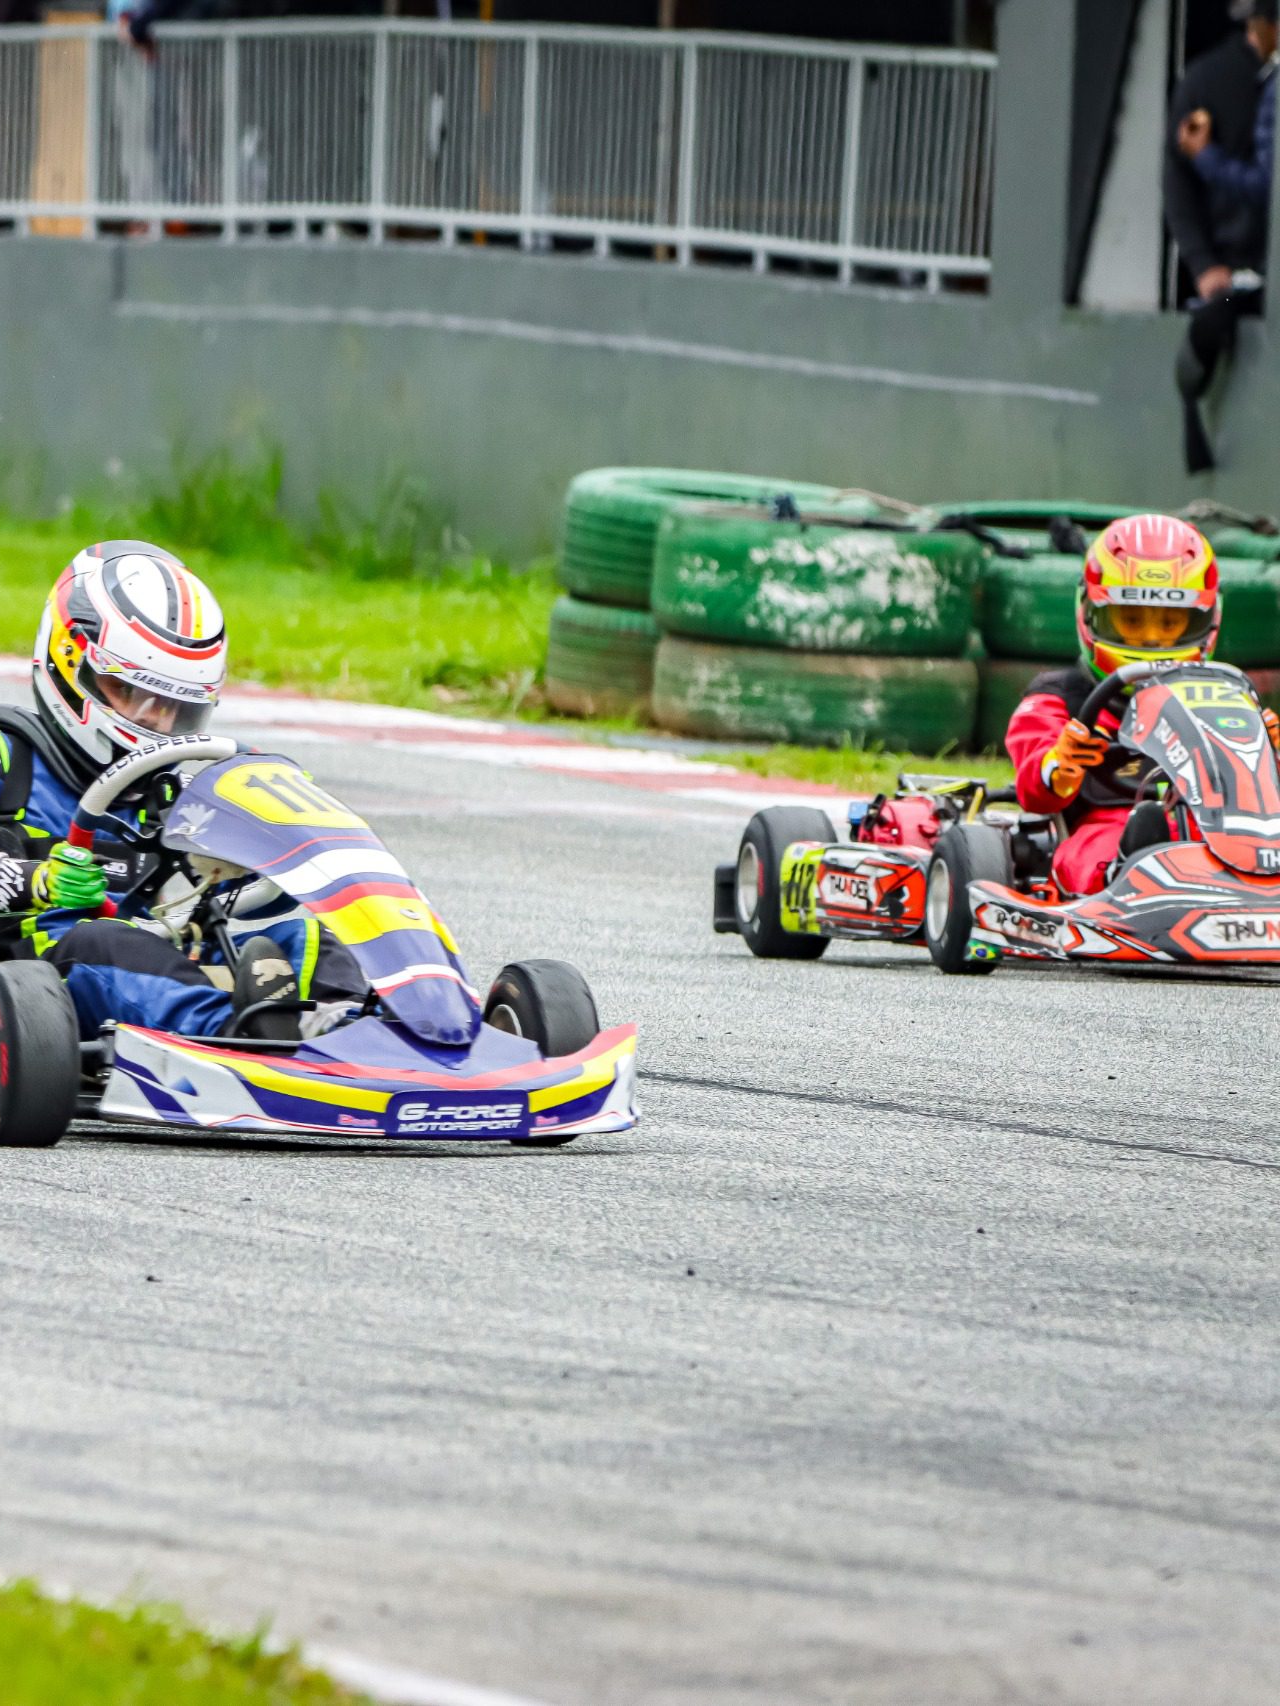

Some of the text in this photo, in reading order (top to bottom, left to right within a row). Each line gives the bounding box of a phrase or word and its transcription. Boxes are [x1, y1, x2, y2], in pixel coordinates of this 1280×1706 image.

[1122, 588, 1185, 601] EIKO
[132, 672, 174, 693] GABRIEL
[785, 863, 815, 908] 112
[397, 1103, 524, 1121] G-FORCE
[398, 1120, 522, 1132] MOTORSPORT
